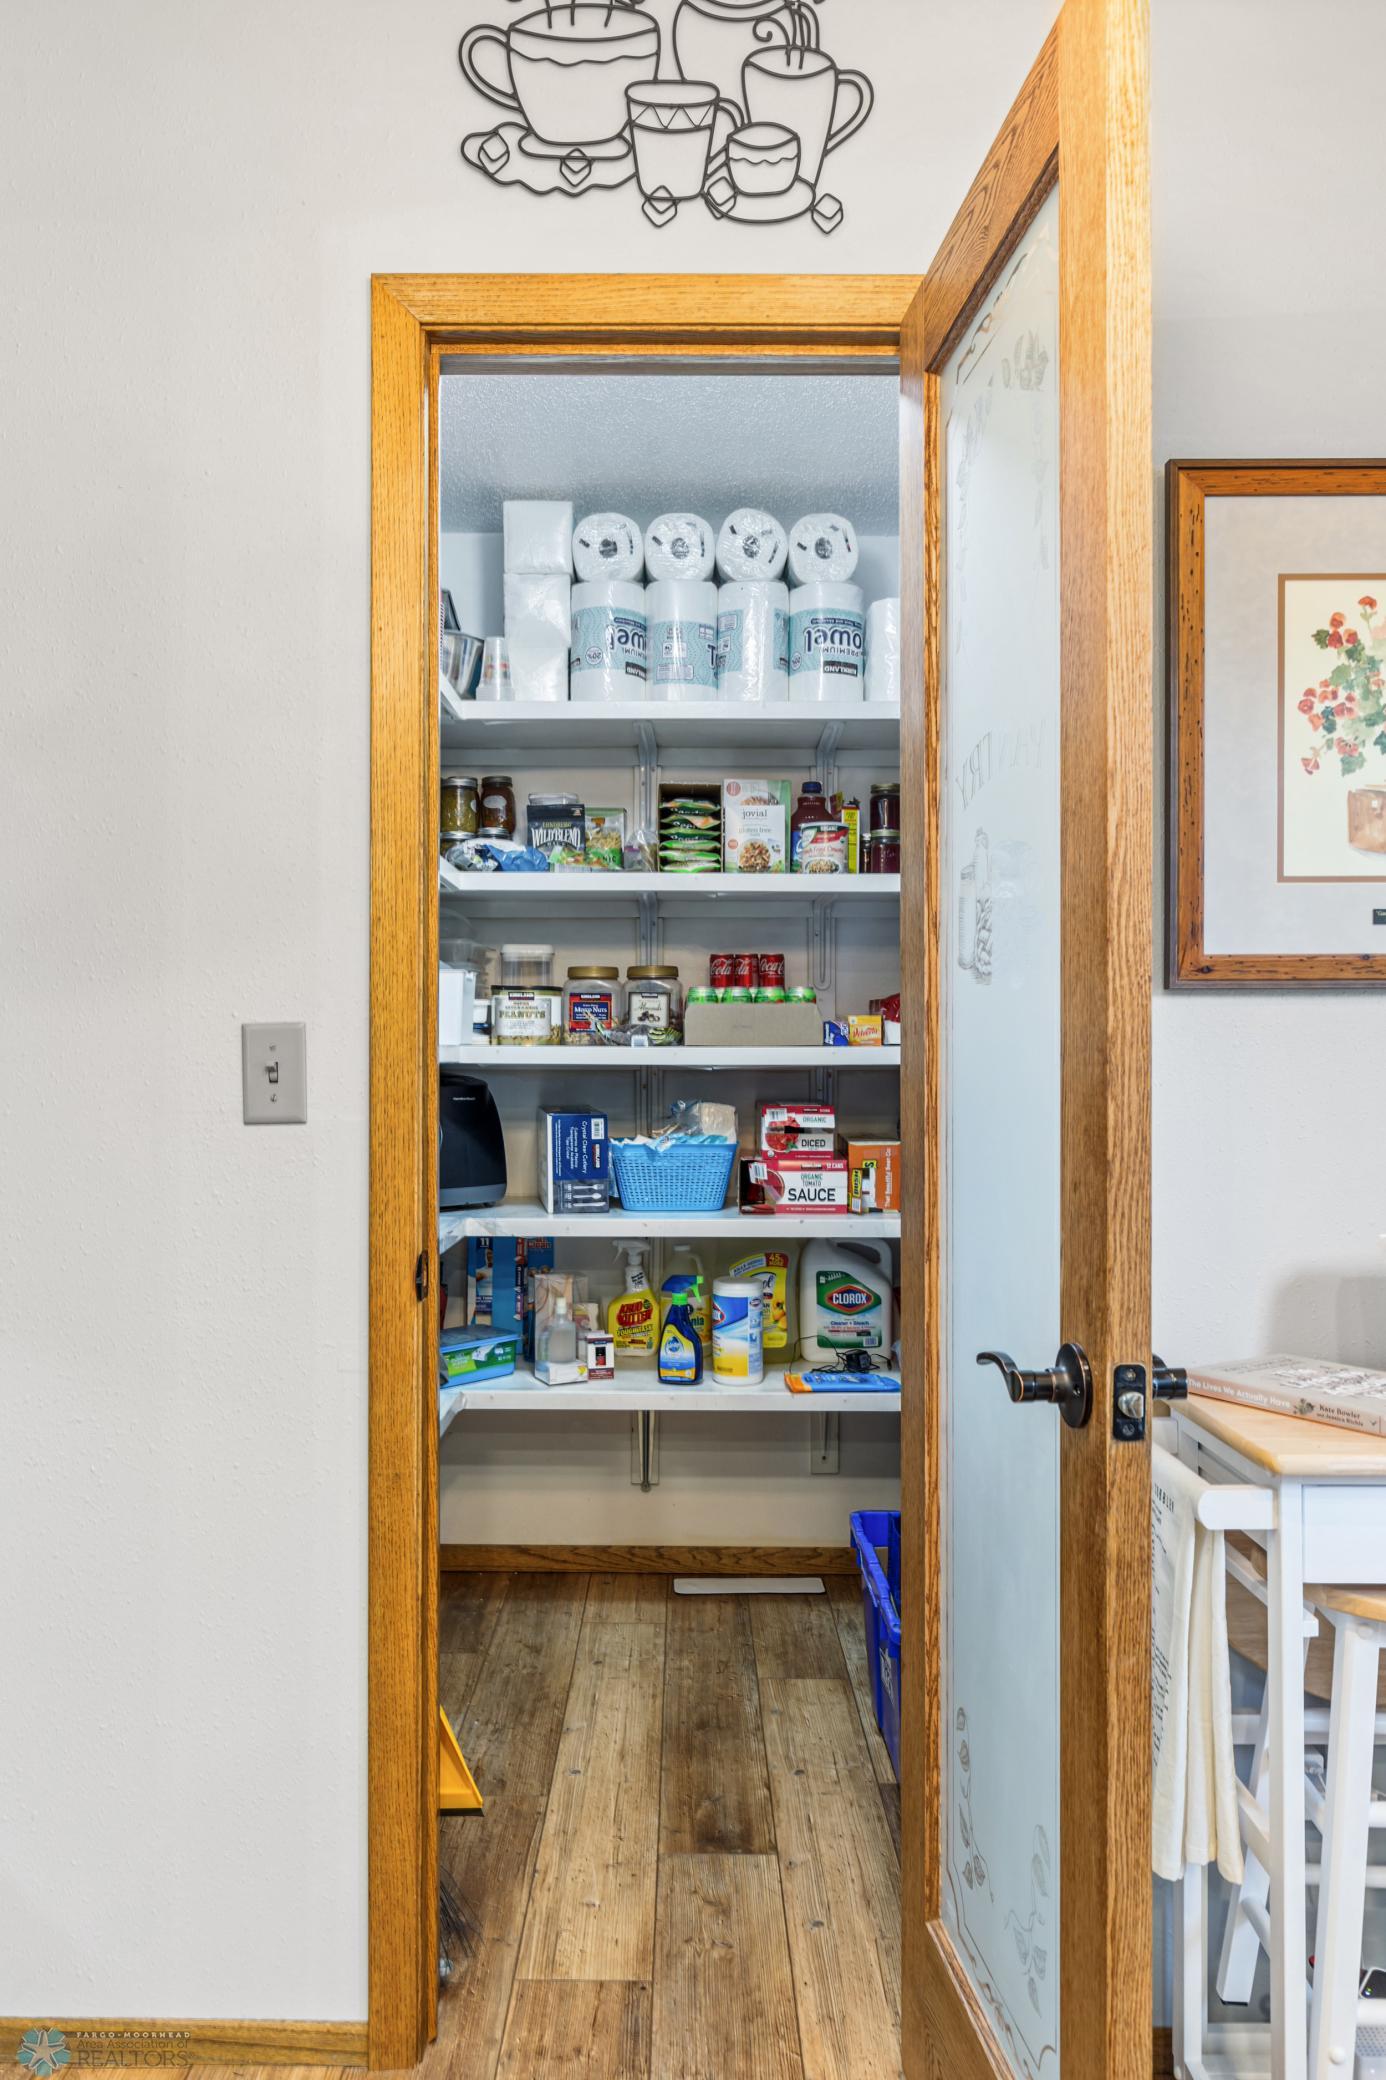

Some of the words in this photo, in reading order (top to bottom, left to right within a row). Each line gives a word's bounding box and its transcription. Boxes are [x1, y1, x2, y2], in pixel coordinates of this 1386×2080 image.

[805, 628, 862, 653] owel
[822, 646, 859, 657] PREMIUM
[824, 664, 857, 675] KIRKLAND
[742, 808, 768, 820] jovial
[499, 1009, 546, 1019] PEANUTS
[802, 1116, 827, 1124] ORGANIC
[801, 1138, 826, 1148] DICED
[800, 1173, 823, 1181] ORGANIC
[802, 1180, 822, 1188] TOMATO
[788, 1188, 836, 1202] SAUCE
[832, 1292, 867, 1305] CLOROX
[1187, 1378, 1201, 1389] The
[1203, 1382, 1222, 1393] Lives
[1223, 1385, 1235, 1396] We
[1236, 1390, 1268, 1404] Actually
[1270, 1396, 1291, 1408] Have
[1319, 1404, 1335, 1413] Kate
[1337, 1408, 1360, 1419] Bowler
